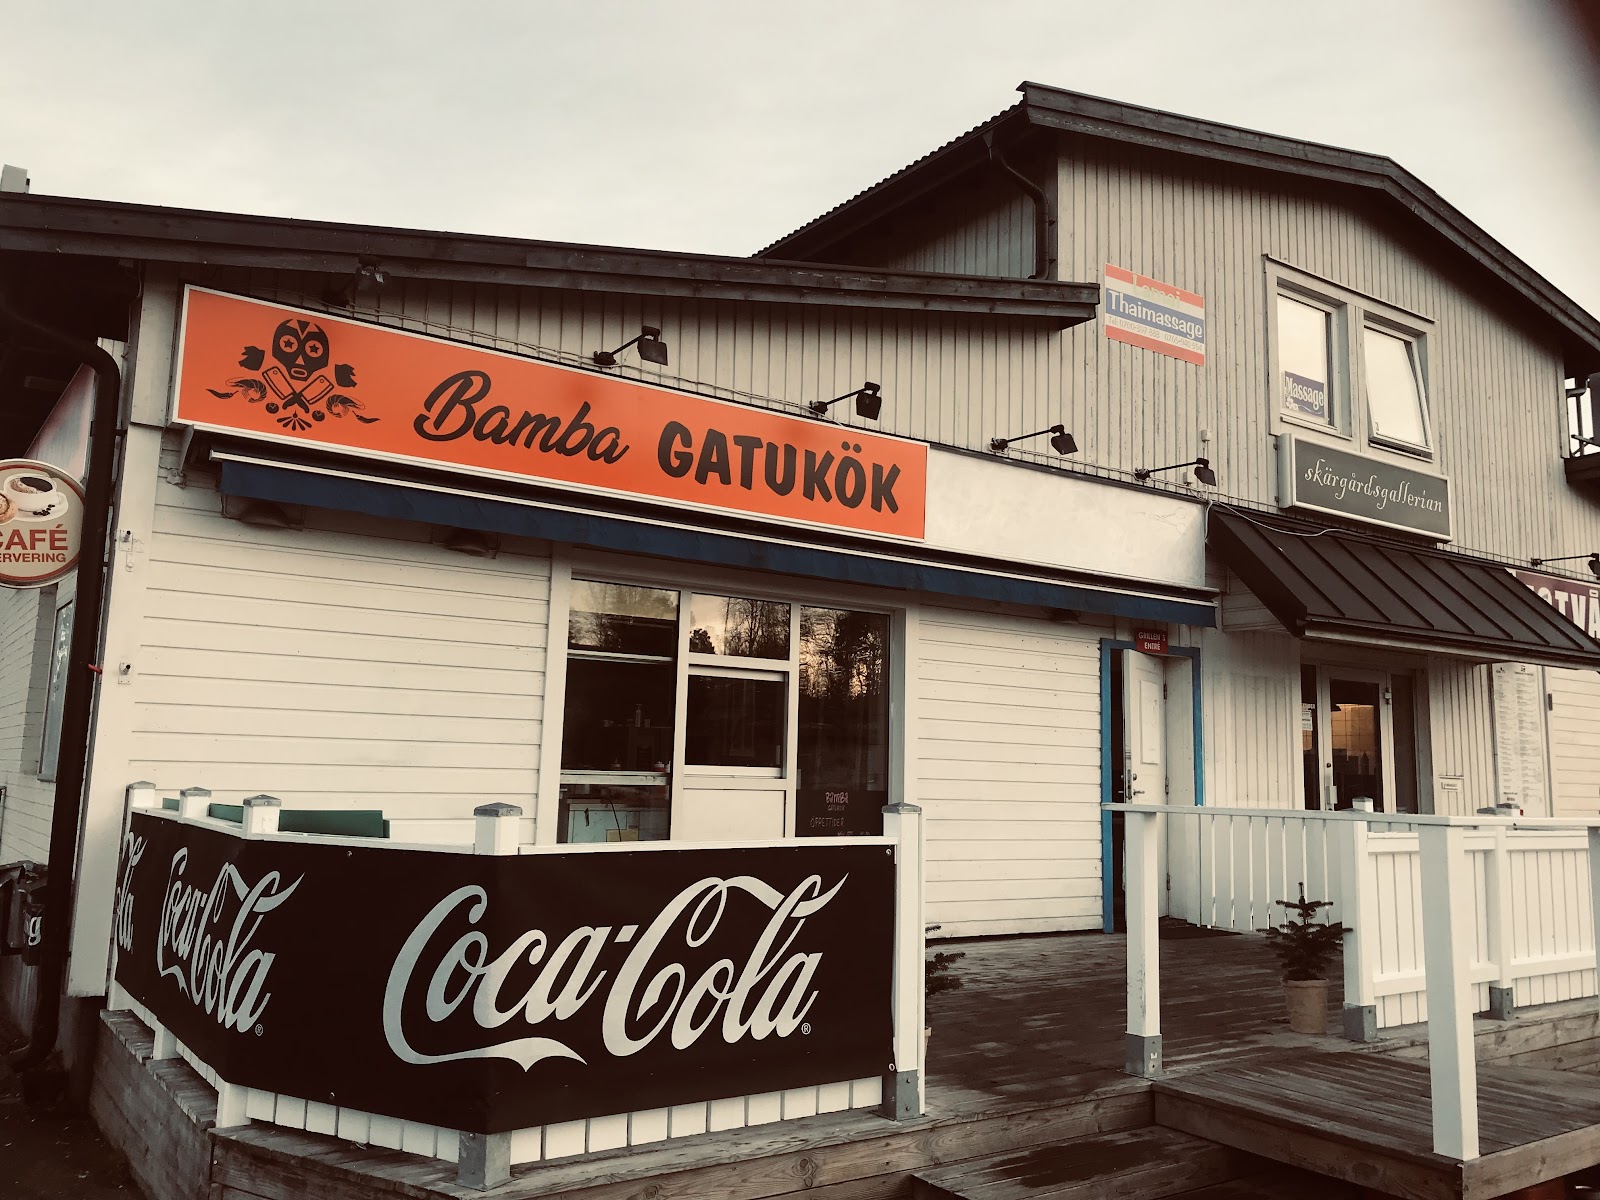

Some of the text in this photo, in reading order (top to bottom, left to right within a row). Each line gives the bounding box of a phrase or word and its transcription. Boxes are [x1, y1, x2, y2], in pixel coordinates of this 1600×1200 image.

[1108, 290, 1203, 339] Thaimassage
[1285, 376, 1324, 410] Massage
[413, 369, 901, 514] Bamba GATUKÖK
[1305, 458, 1442, 513] skärgårdsgallerian
[0, 524, 68, 550] AFÉ
[383, 872, 849, 1071] Coca-Cola
